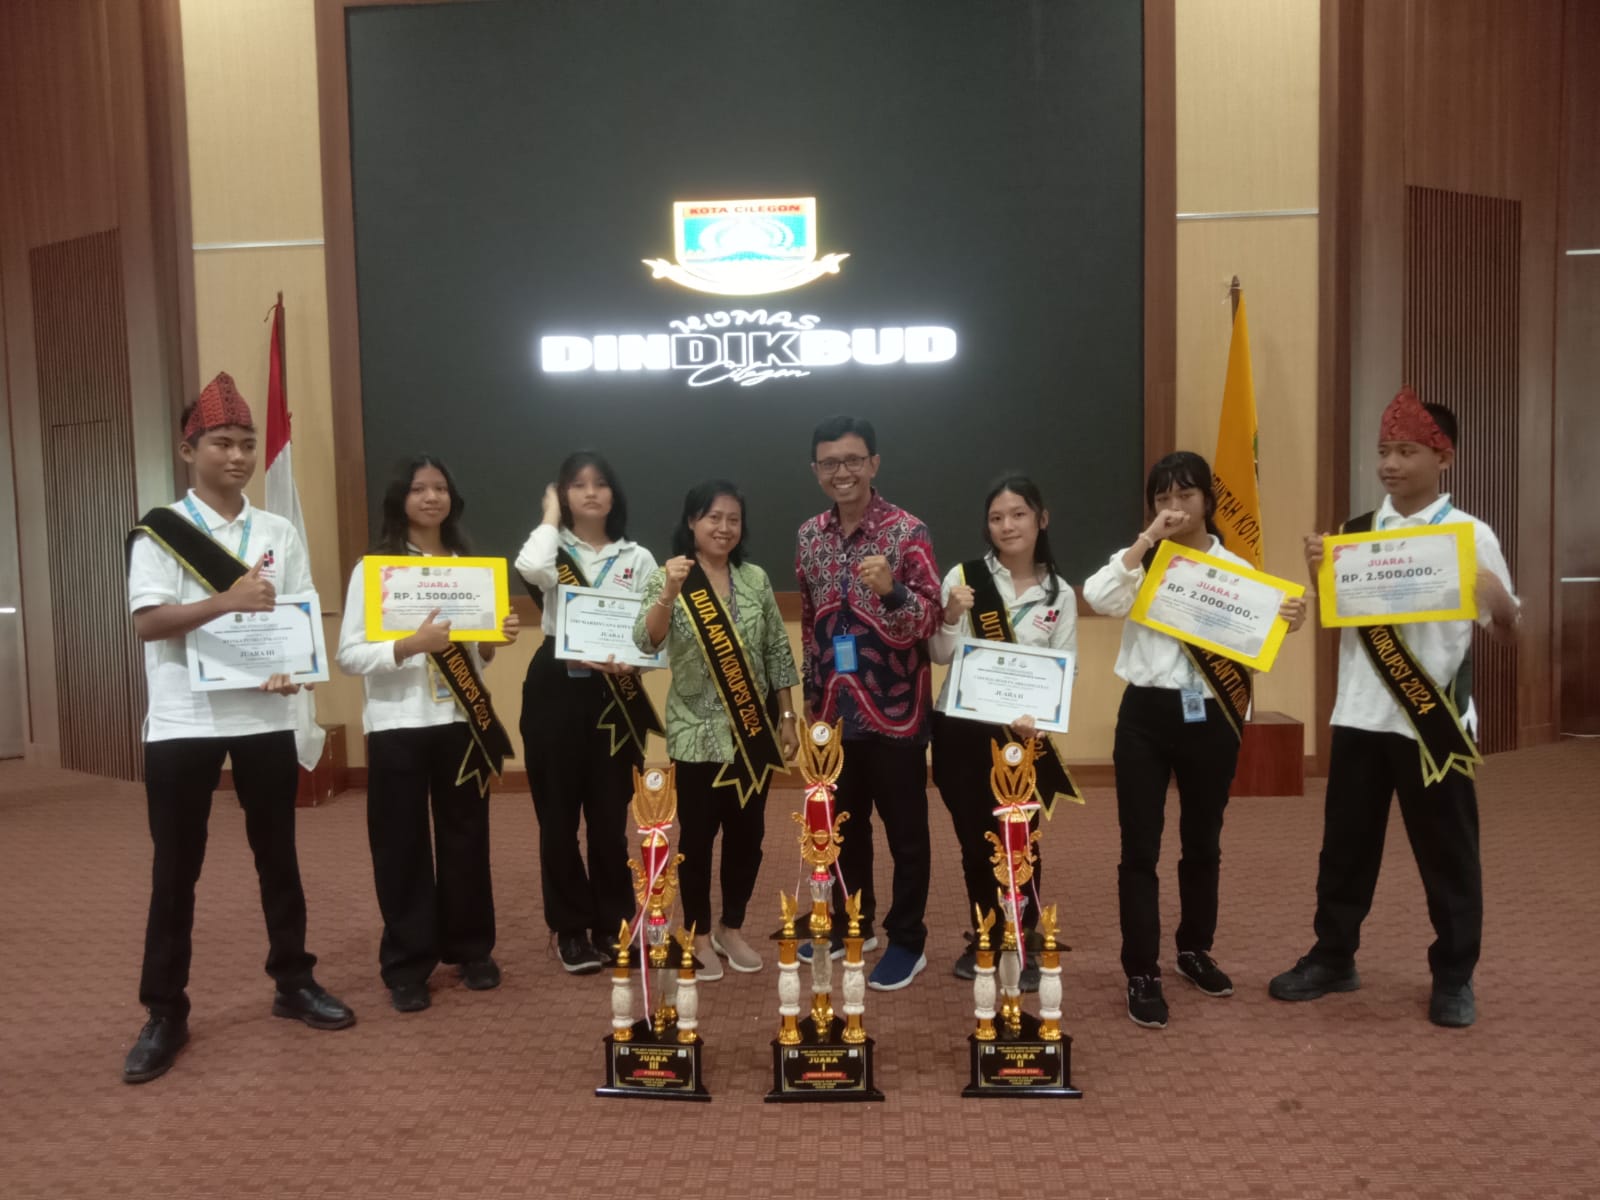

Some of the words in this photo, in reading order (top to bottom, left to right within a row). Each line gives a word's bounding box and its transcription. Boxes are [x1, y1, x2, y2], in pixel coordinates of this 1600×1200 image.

[690, 206, 728, 215] KOTA
[734, 204, 801, 213] CILEGON
[541, 325, 957, 372] DINDIKBUD
[1232, 513, 1261, 549] KOTA
[1368, 557, 1406, 566] JUARA
[558, 563, 580, 586] DUT
[1341, 574, 1363, 583] RP.
[393, 592, 413, 600] RP.
[1167, 582, 1186, 596] RP.
[1196, 581, 1232, 599] JUARA
[1232, 593, 1240, 601] 2
[690, 588, 718, 625] DUTA
[705, 623, 734, 659] ANTI
[719, 653, 752, 706] KORUPSI
[1369, 624, 1412, 681] KORUPSI
[1400, 678, 1437, 715] 2024
[446, 652, 480, 703] KORUPSI
[473, 698, 491, 731] 2024
[739, 703, 763, 737] 2024
[649, 1061, 659, 1070] III
[808, 1056, 839, 1064] JUARA
